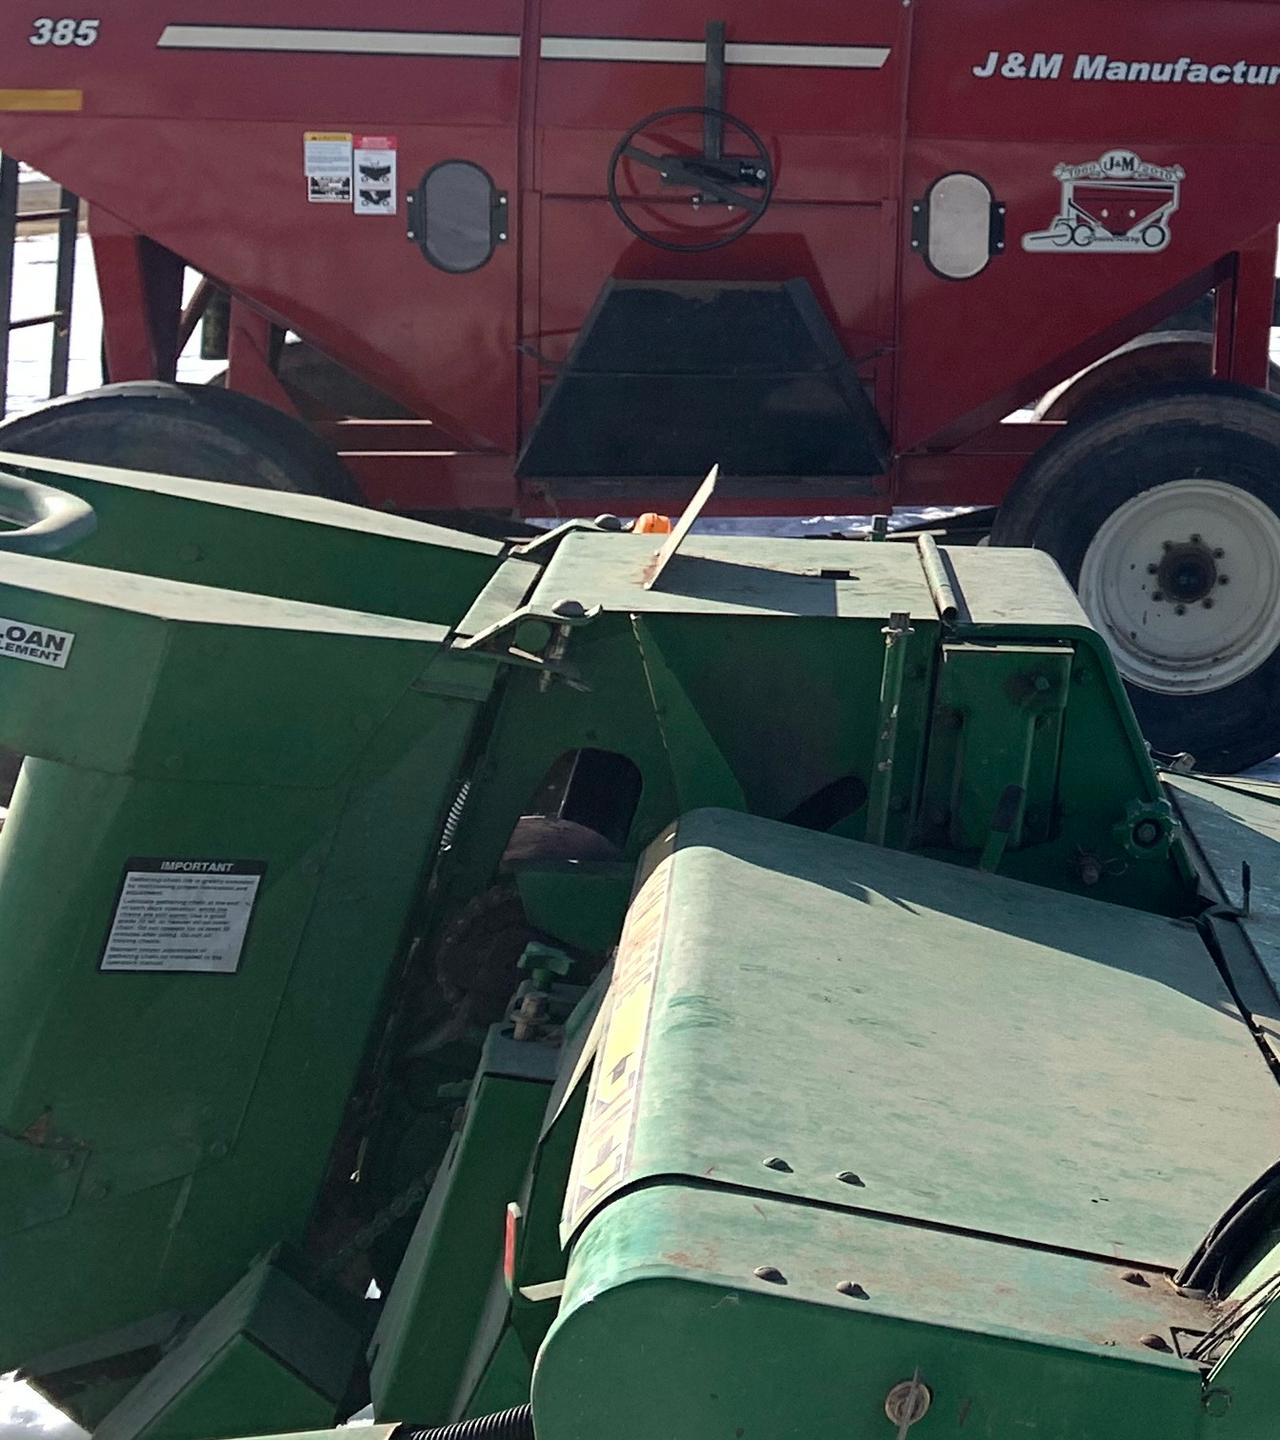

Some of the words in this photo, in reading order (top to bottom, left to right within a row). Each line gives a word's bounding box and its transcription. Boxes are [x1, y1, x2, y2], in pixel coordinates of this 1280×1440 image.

[28, 17, 101, 47] 385
[972, 51, 1064, 79] J&M
[1103, 156, 1136, 172] J&M
[0, 625, 66, 652] OAN
[0, 642, 62, 662] EMENT
[160, 861, 235, 873] IMPORTANT
